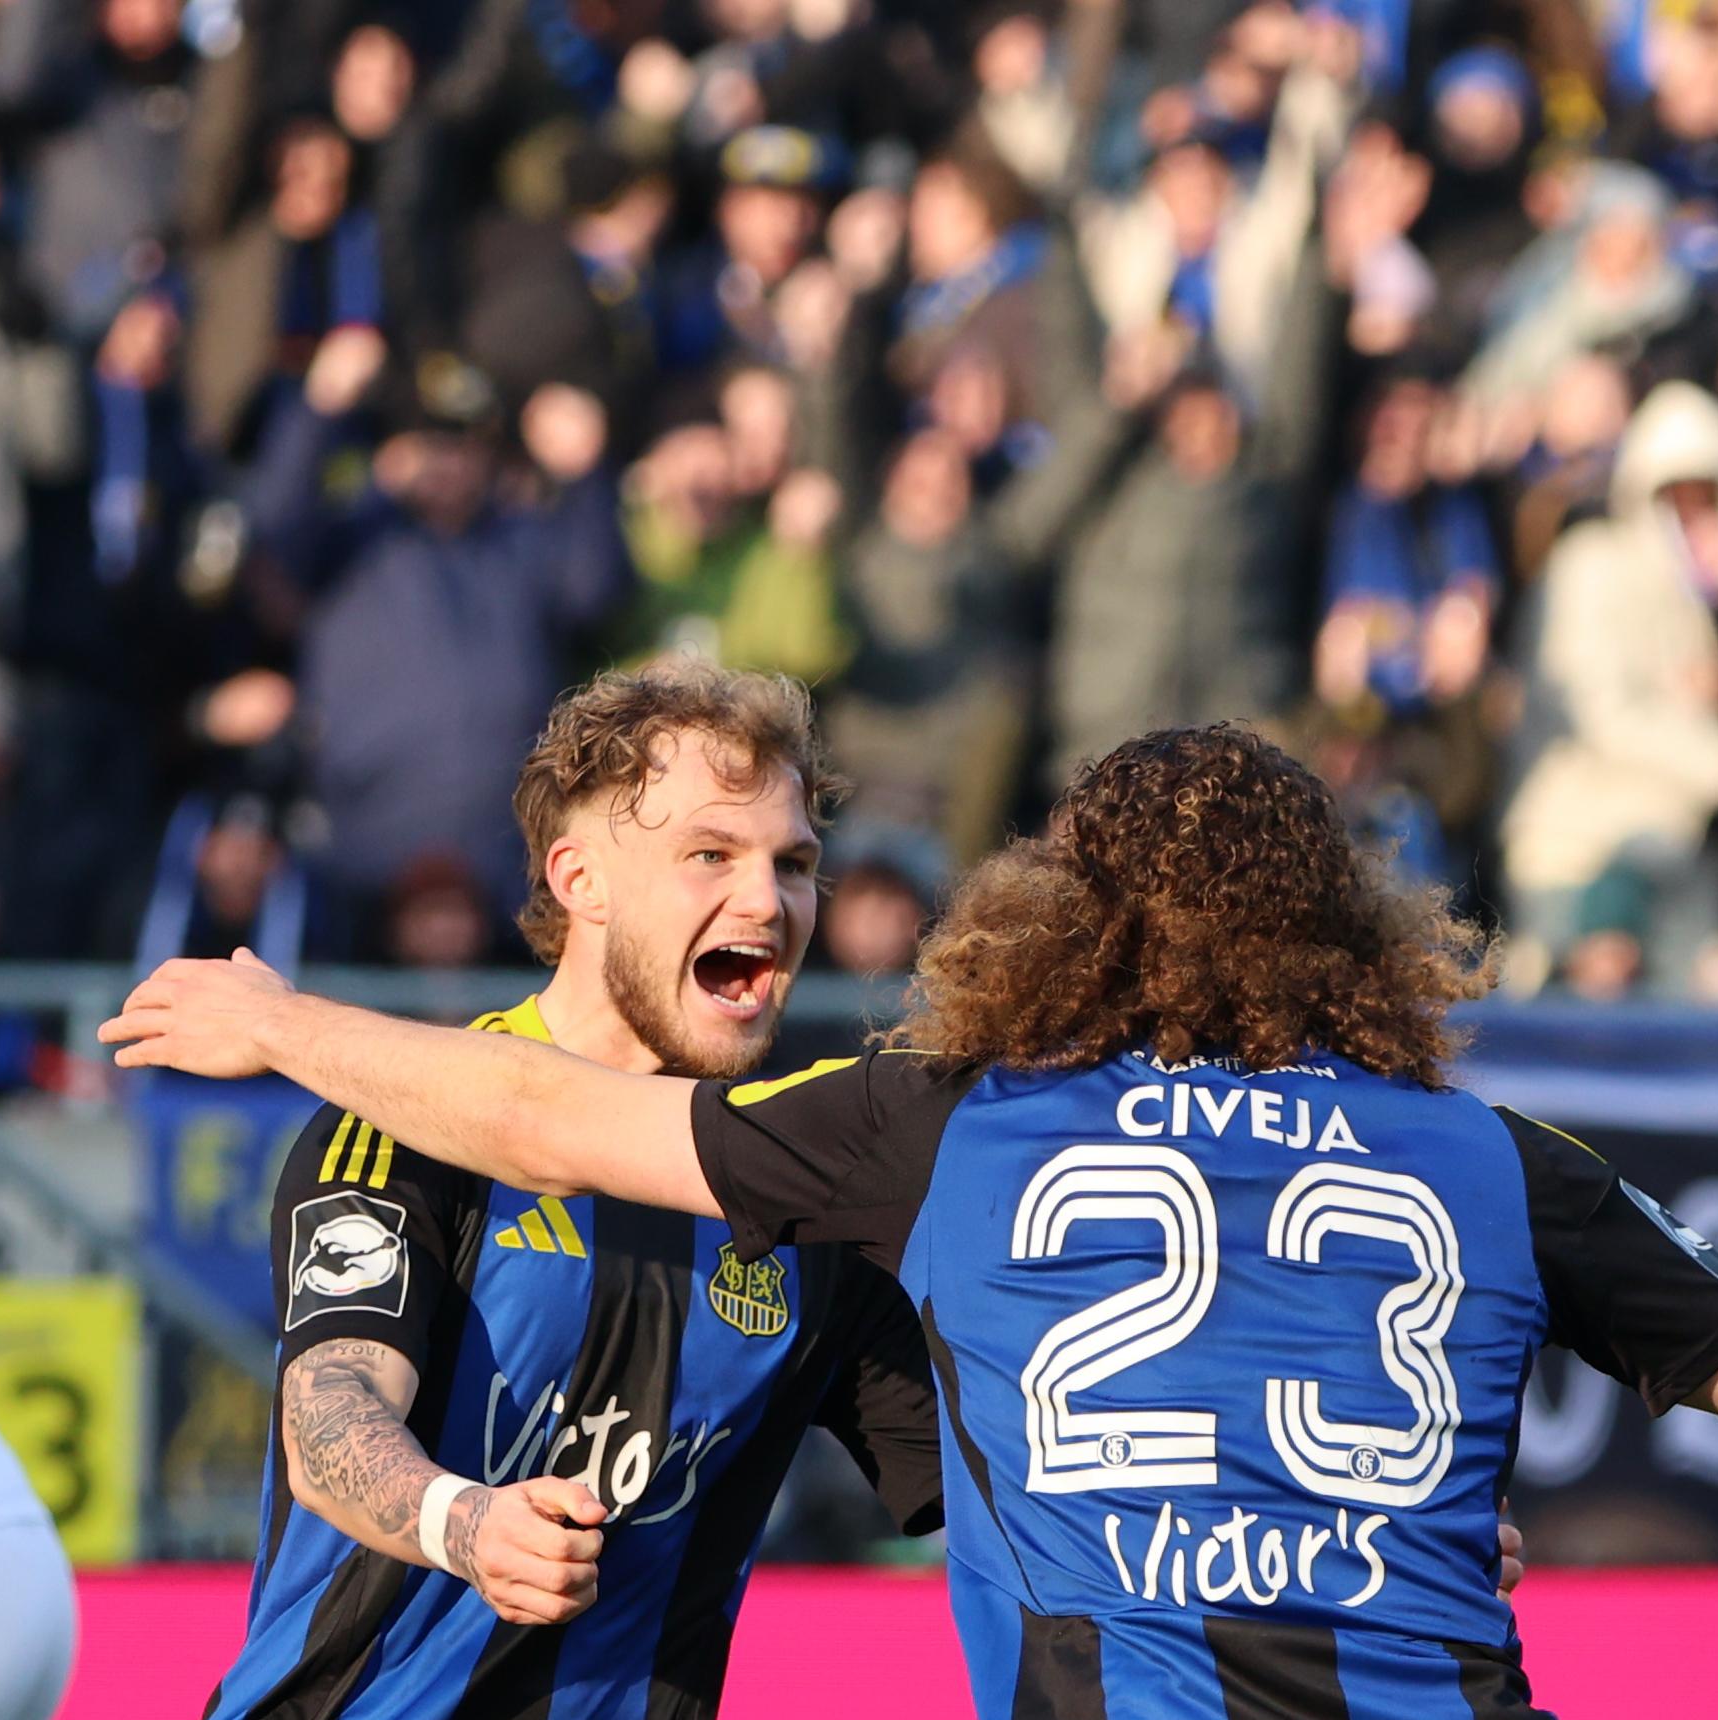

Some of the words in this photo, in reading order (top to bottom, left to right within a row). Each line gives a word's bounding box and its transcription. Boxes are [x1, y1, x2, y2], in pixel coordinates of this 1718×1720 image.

[1116, 1083, 1371, 1154] CIVEJA
[1011, 1144, 1466, 1507] 23
[1104, 1501, 1390, 1608] Victor's
